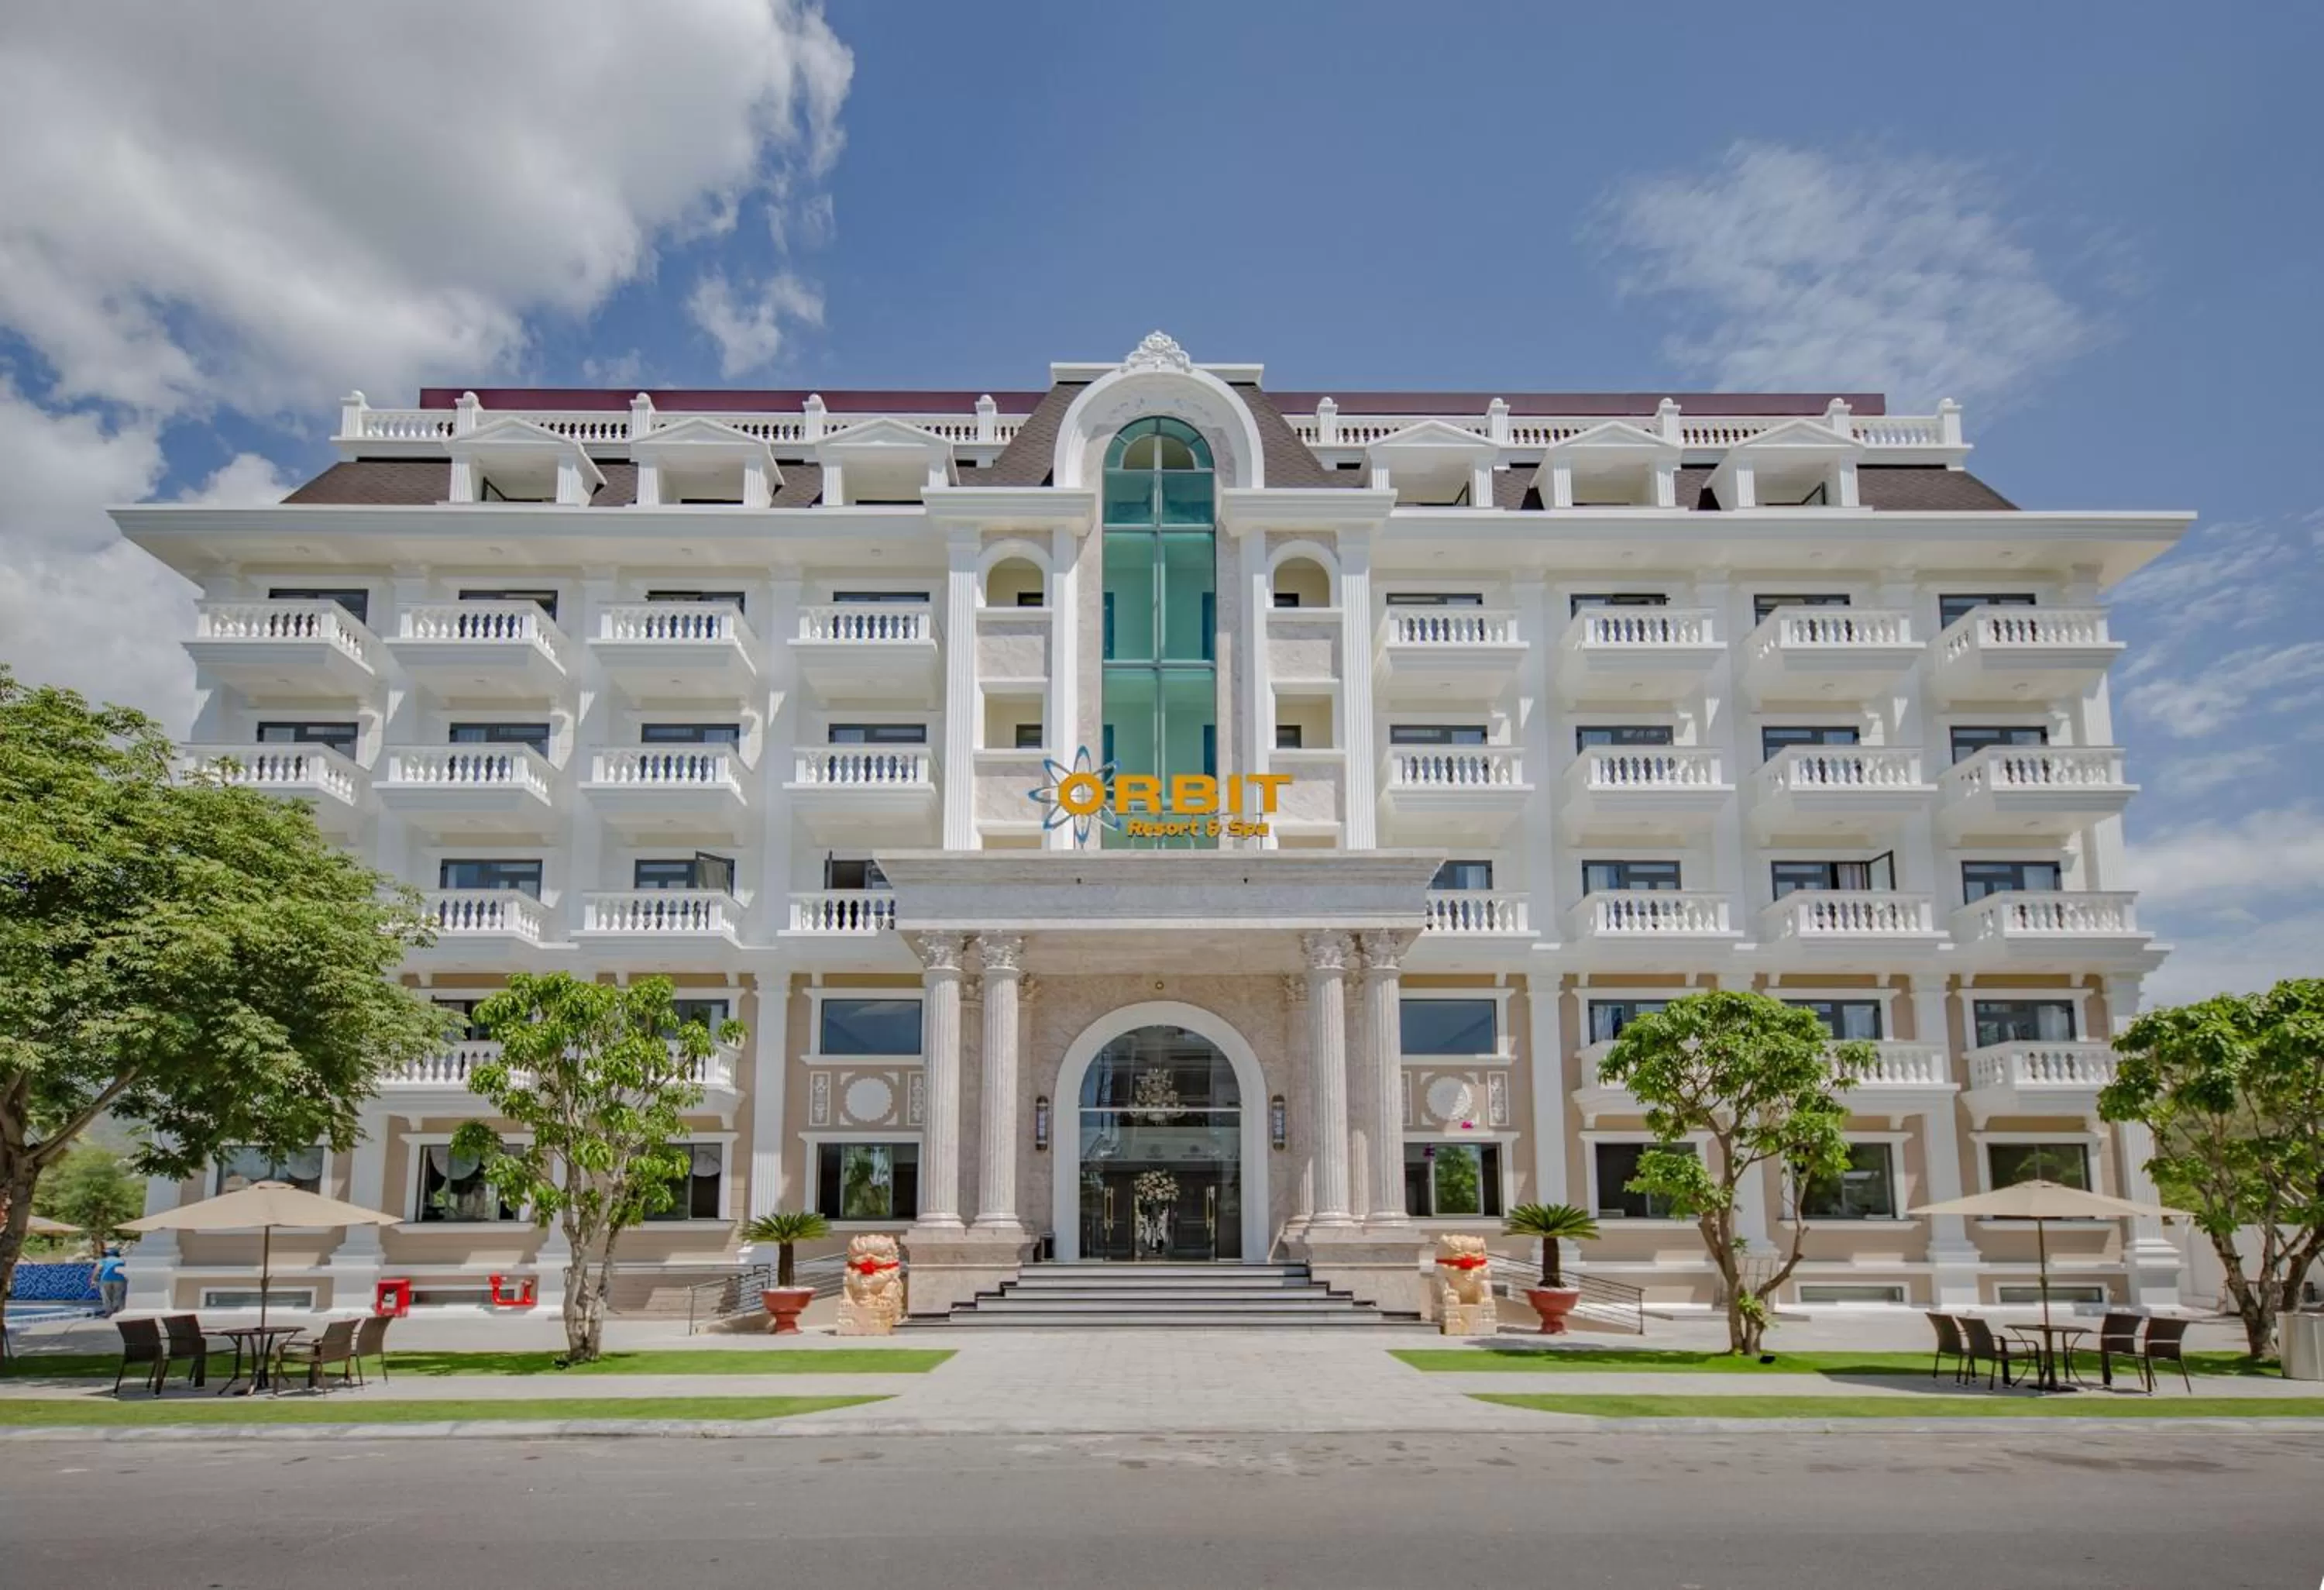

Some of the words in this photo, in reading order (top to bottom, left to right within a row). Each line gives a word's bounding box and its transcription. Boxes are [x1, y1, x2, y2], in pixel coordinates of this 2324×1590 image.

[1058, 773, 1294, 814] ORBIT
[1128, 819, 1198, 838] Resort
[1205, 818, 1221, 838] &
[1228, 819, 1270, 840] Spa
